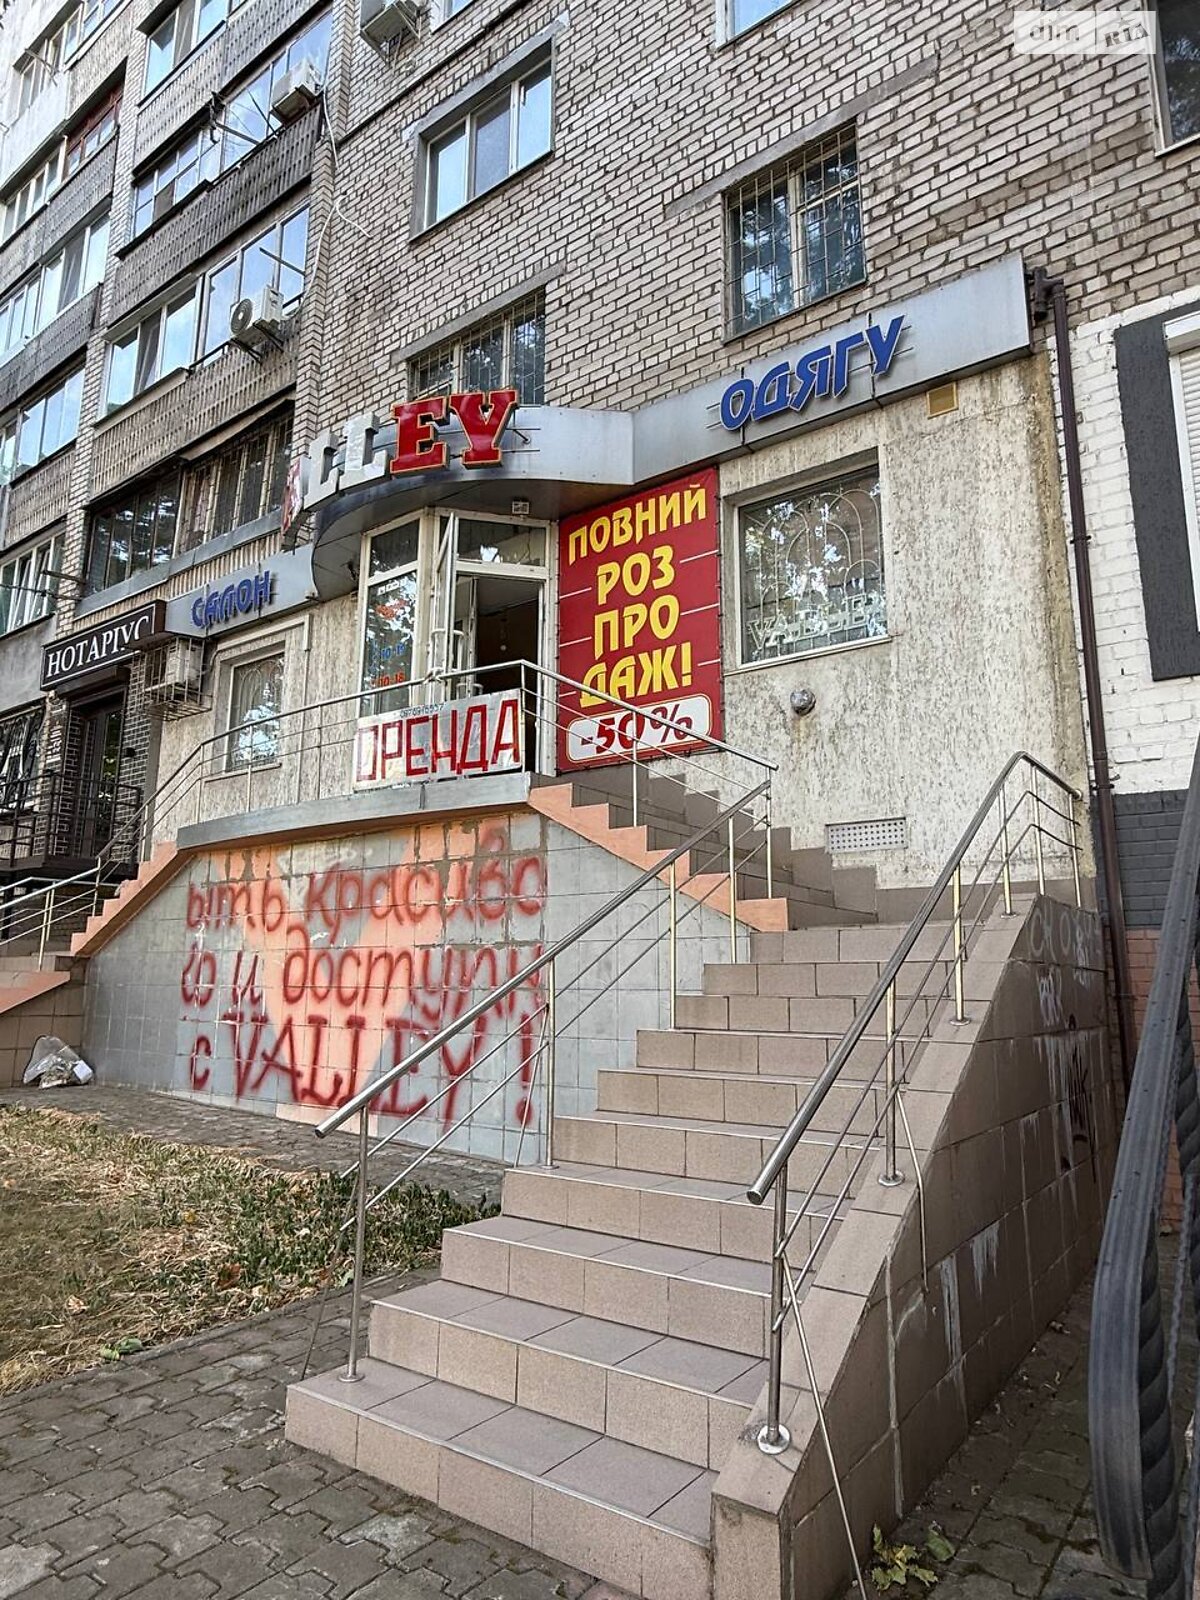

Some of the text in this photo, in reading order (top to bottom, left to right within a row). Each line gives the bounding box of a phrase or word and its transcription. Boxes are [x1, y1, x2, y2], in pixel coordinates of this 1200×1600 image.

[719, 314, 905, 431] ОДЯГУ
[568, 484, 706, 565] ПОВНИЙ
[192, 570, 270, 628] САЛОН
[597, 545, 675, 605] РОЗ
[594, 594, 680, 661] ПРО
[579, 641, 692, 708] ДАЖ!
[581, 703, 693, 754] -50%
